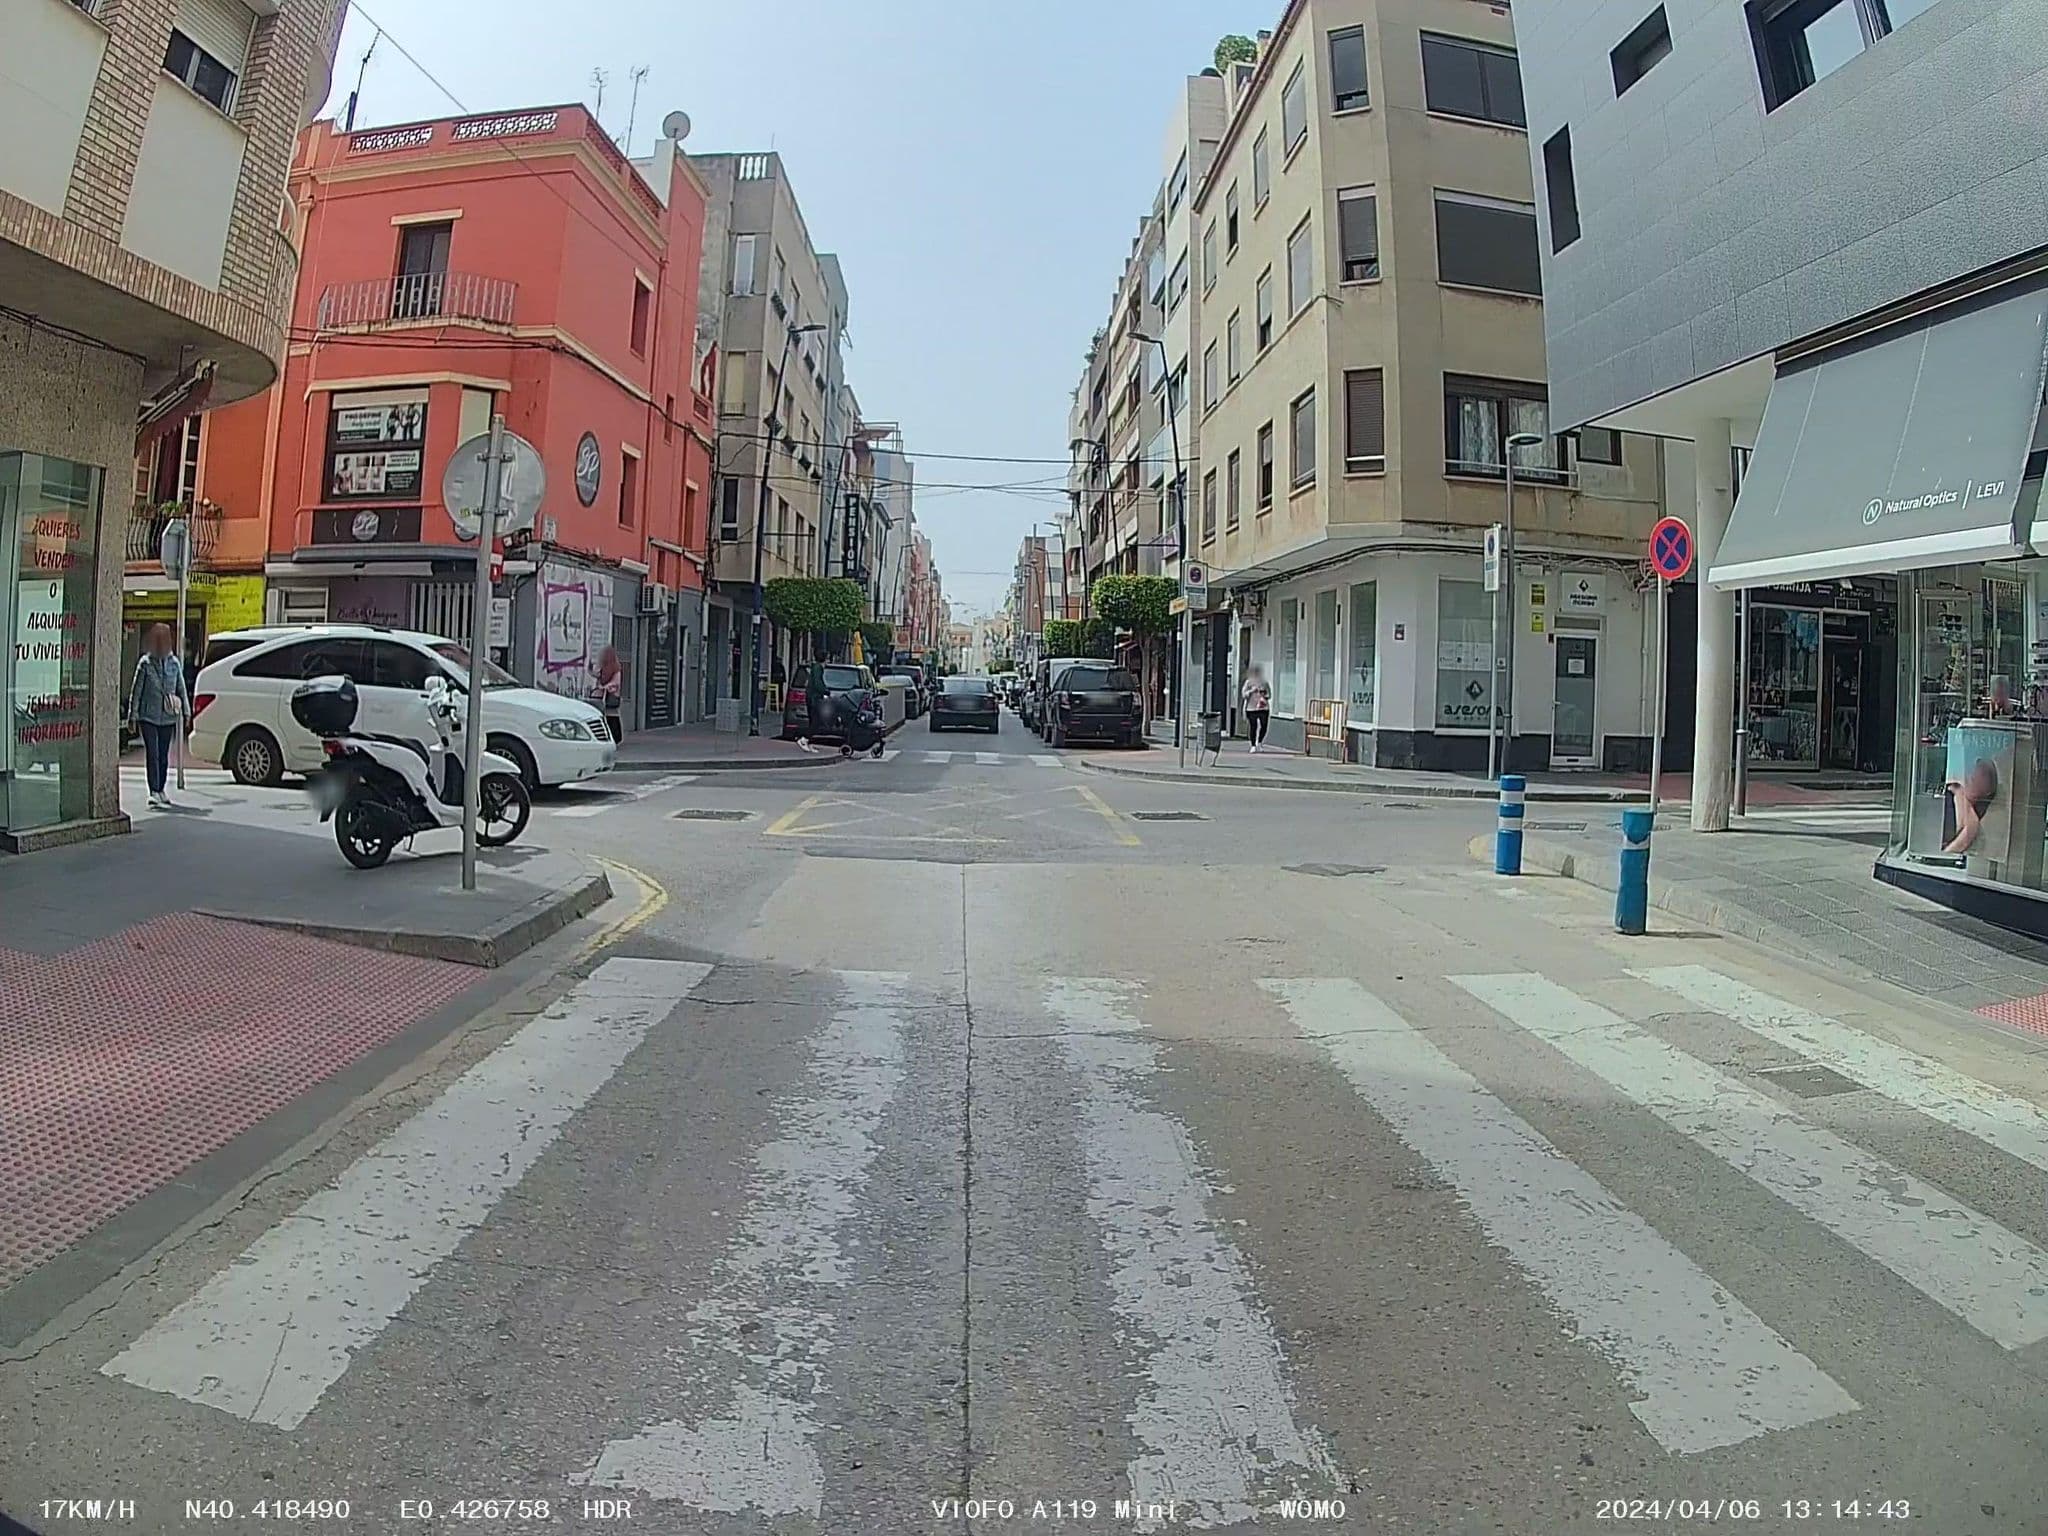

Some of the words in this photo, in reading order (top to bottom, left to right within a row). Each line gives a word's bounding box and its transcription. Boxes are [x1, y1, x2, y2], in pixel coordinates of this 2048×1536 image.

[1885, 497, 1922, 514] Natural
[1923, 490, 1958, 509] Optics
[1976, 480, 2006, 499] LEVI
[32, 517, 81, 541] ¿QUIERES
[49, 582, 58, 599] O
[27, 612, 78, 631] ALQUILAR
[15, 644, 30, 661] TU
